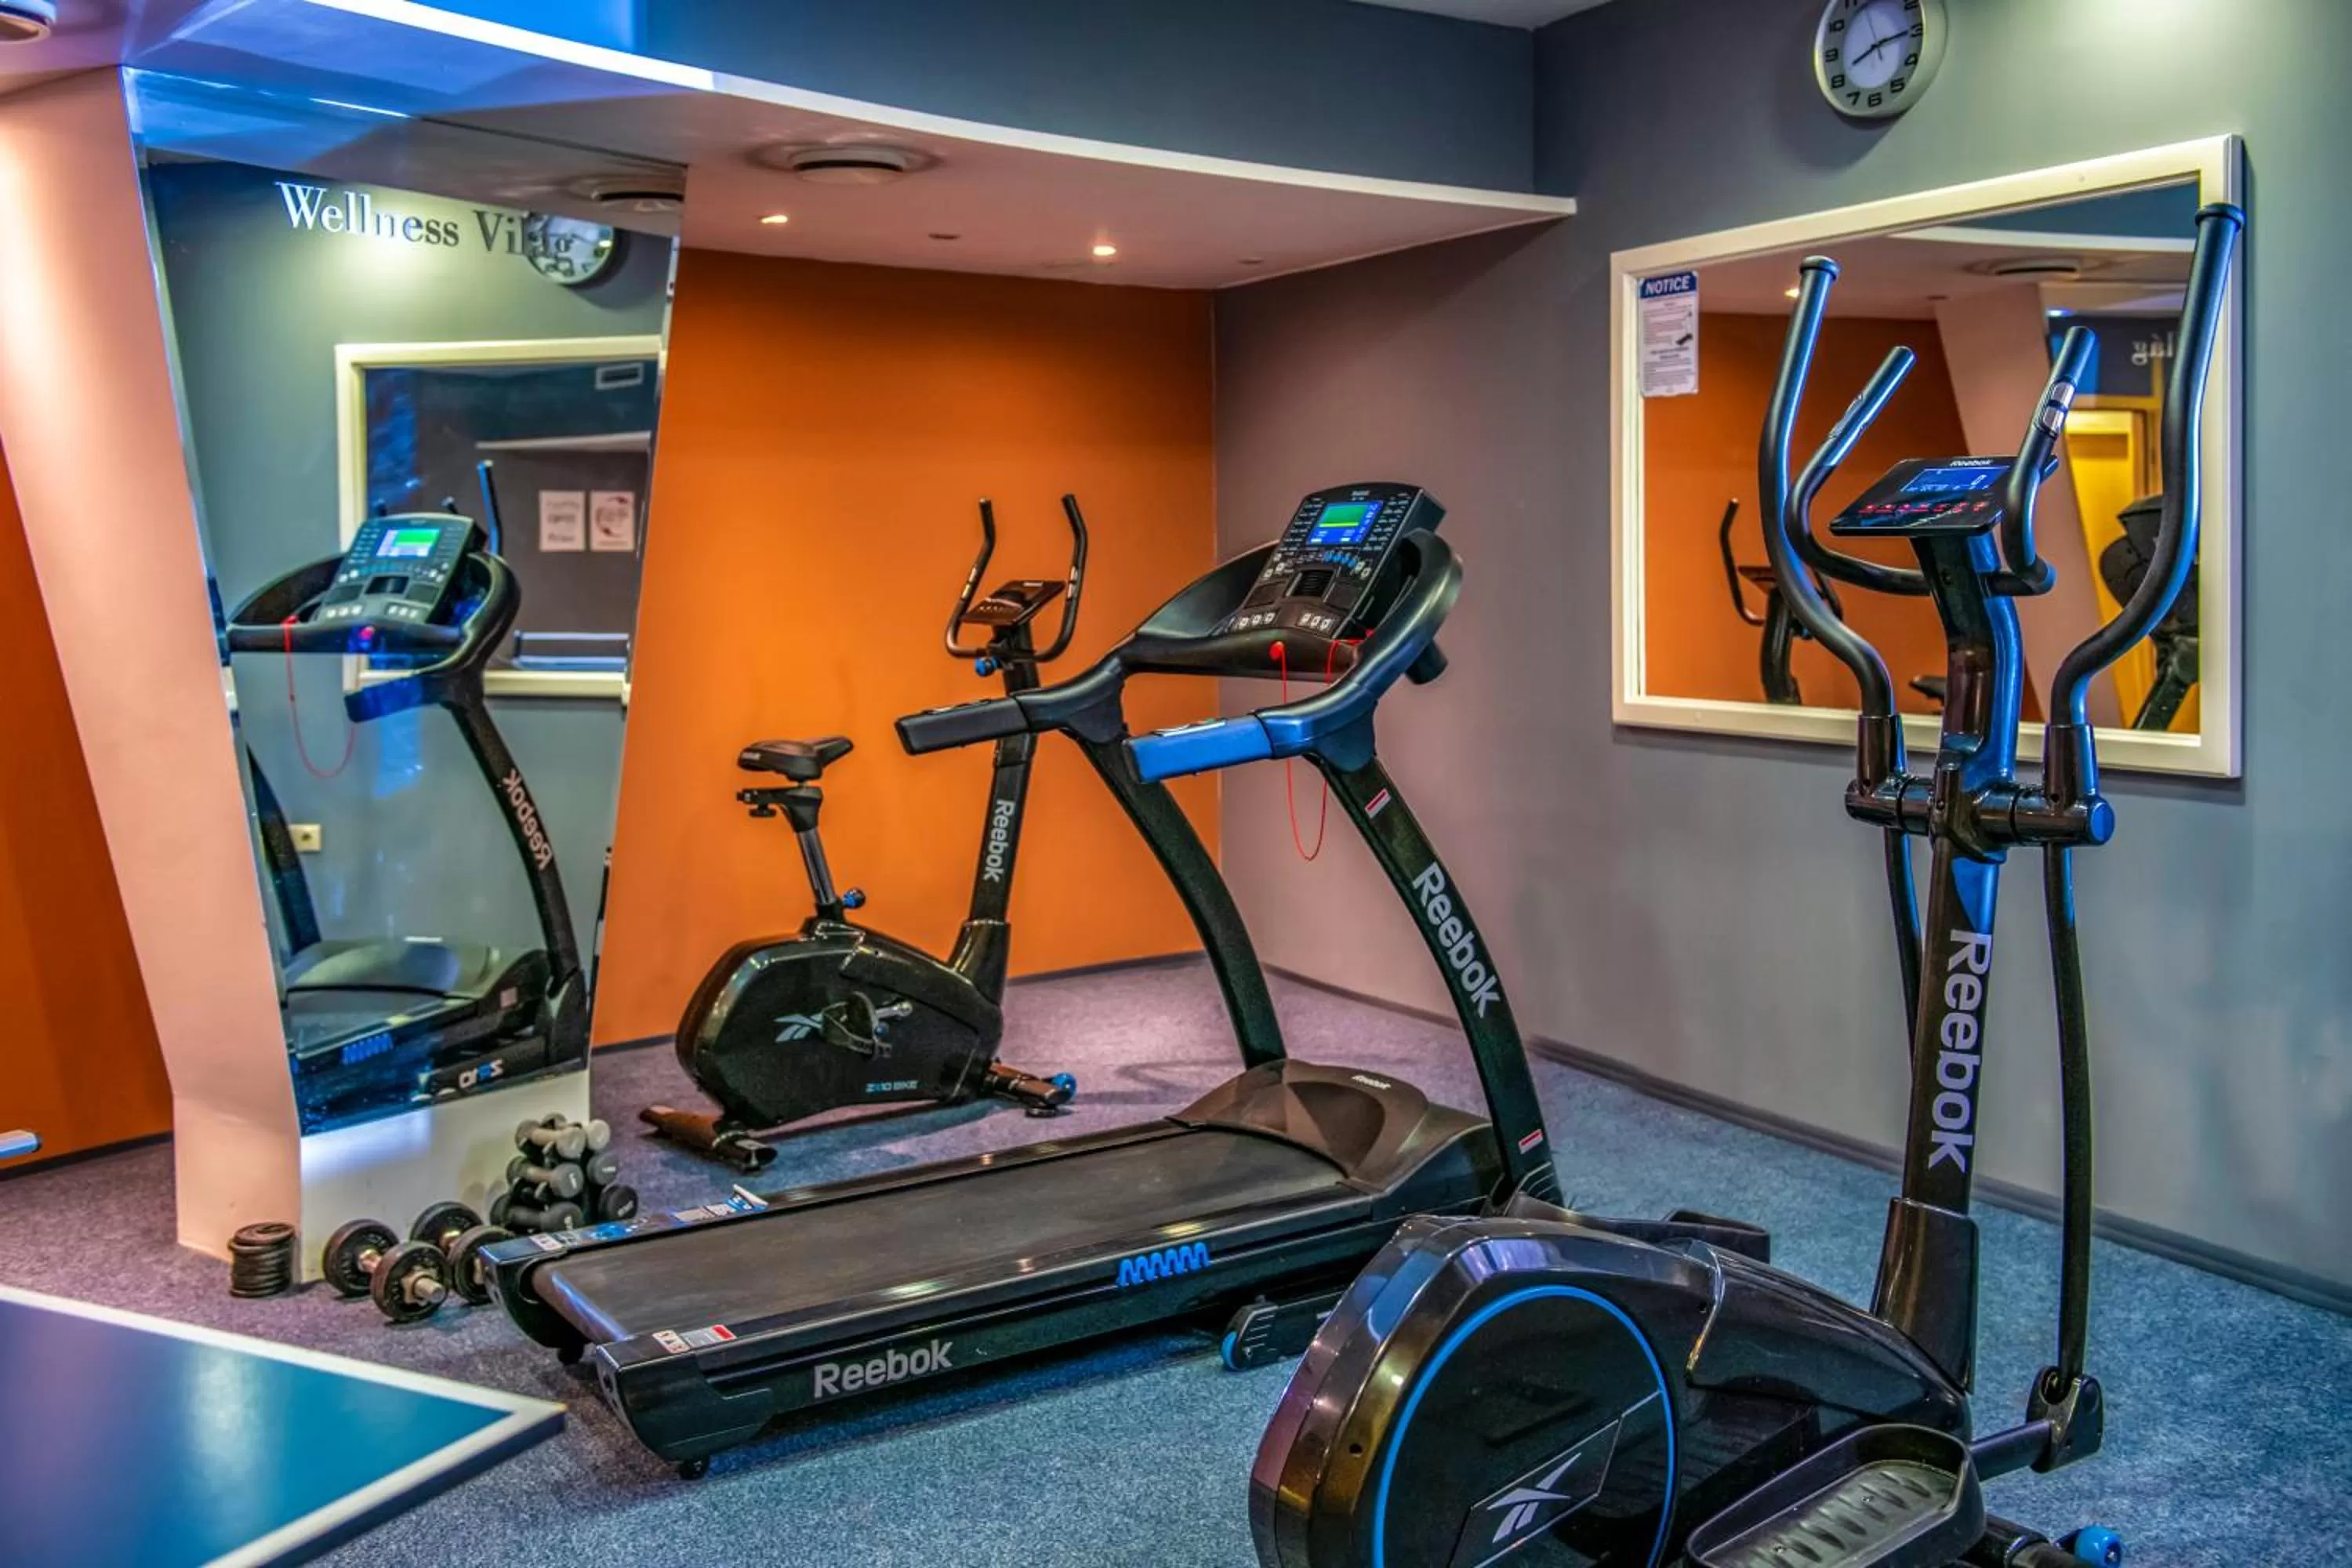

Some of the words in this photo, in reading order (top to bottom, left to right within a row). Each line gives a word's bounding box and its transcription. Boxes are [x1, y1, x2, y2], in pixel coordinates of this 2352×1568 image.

[1829, 19, 1845, 34] 10
[1910, 23, 1923, 38] 3
[1825, 48, 1838, 62] 9
[1904, 53, 1918, 66] 4
[1831, 74, 1845, 89] 8
[1890, 78, 1905, 93] 5
[1846, 91, 1860, 106] 7
[1867, 93, 1882, 107] 6
[274, 181, 460, 248] Wellness
[1645, 275, 1691, 296] NOTICE
[982, 799, 1016, 883] Reebok
[1412, 861, 1501, 1019] Reebok
[1927, 929, 1993, 1174] Reebok
[813, 1338, 954, 1399] Reebok
